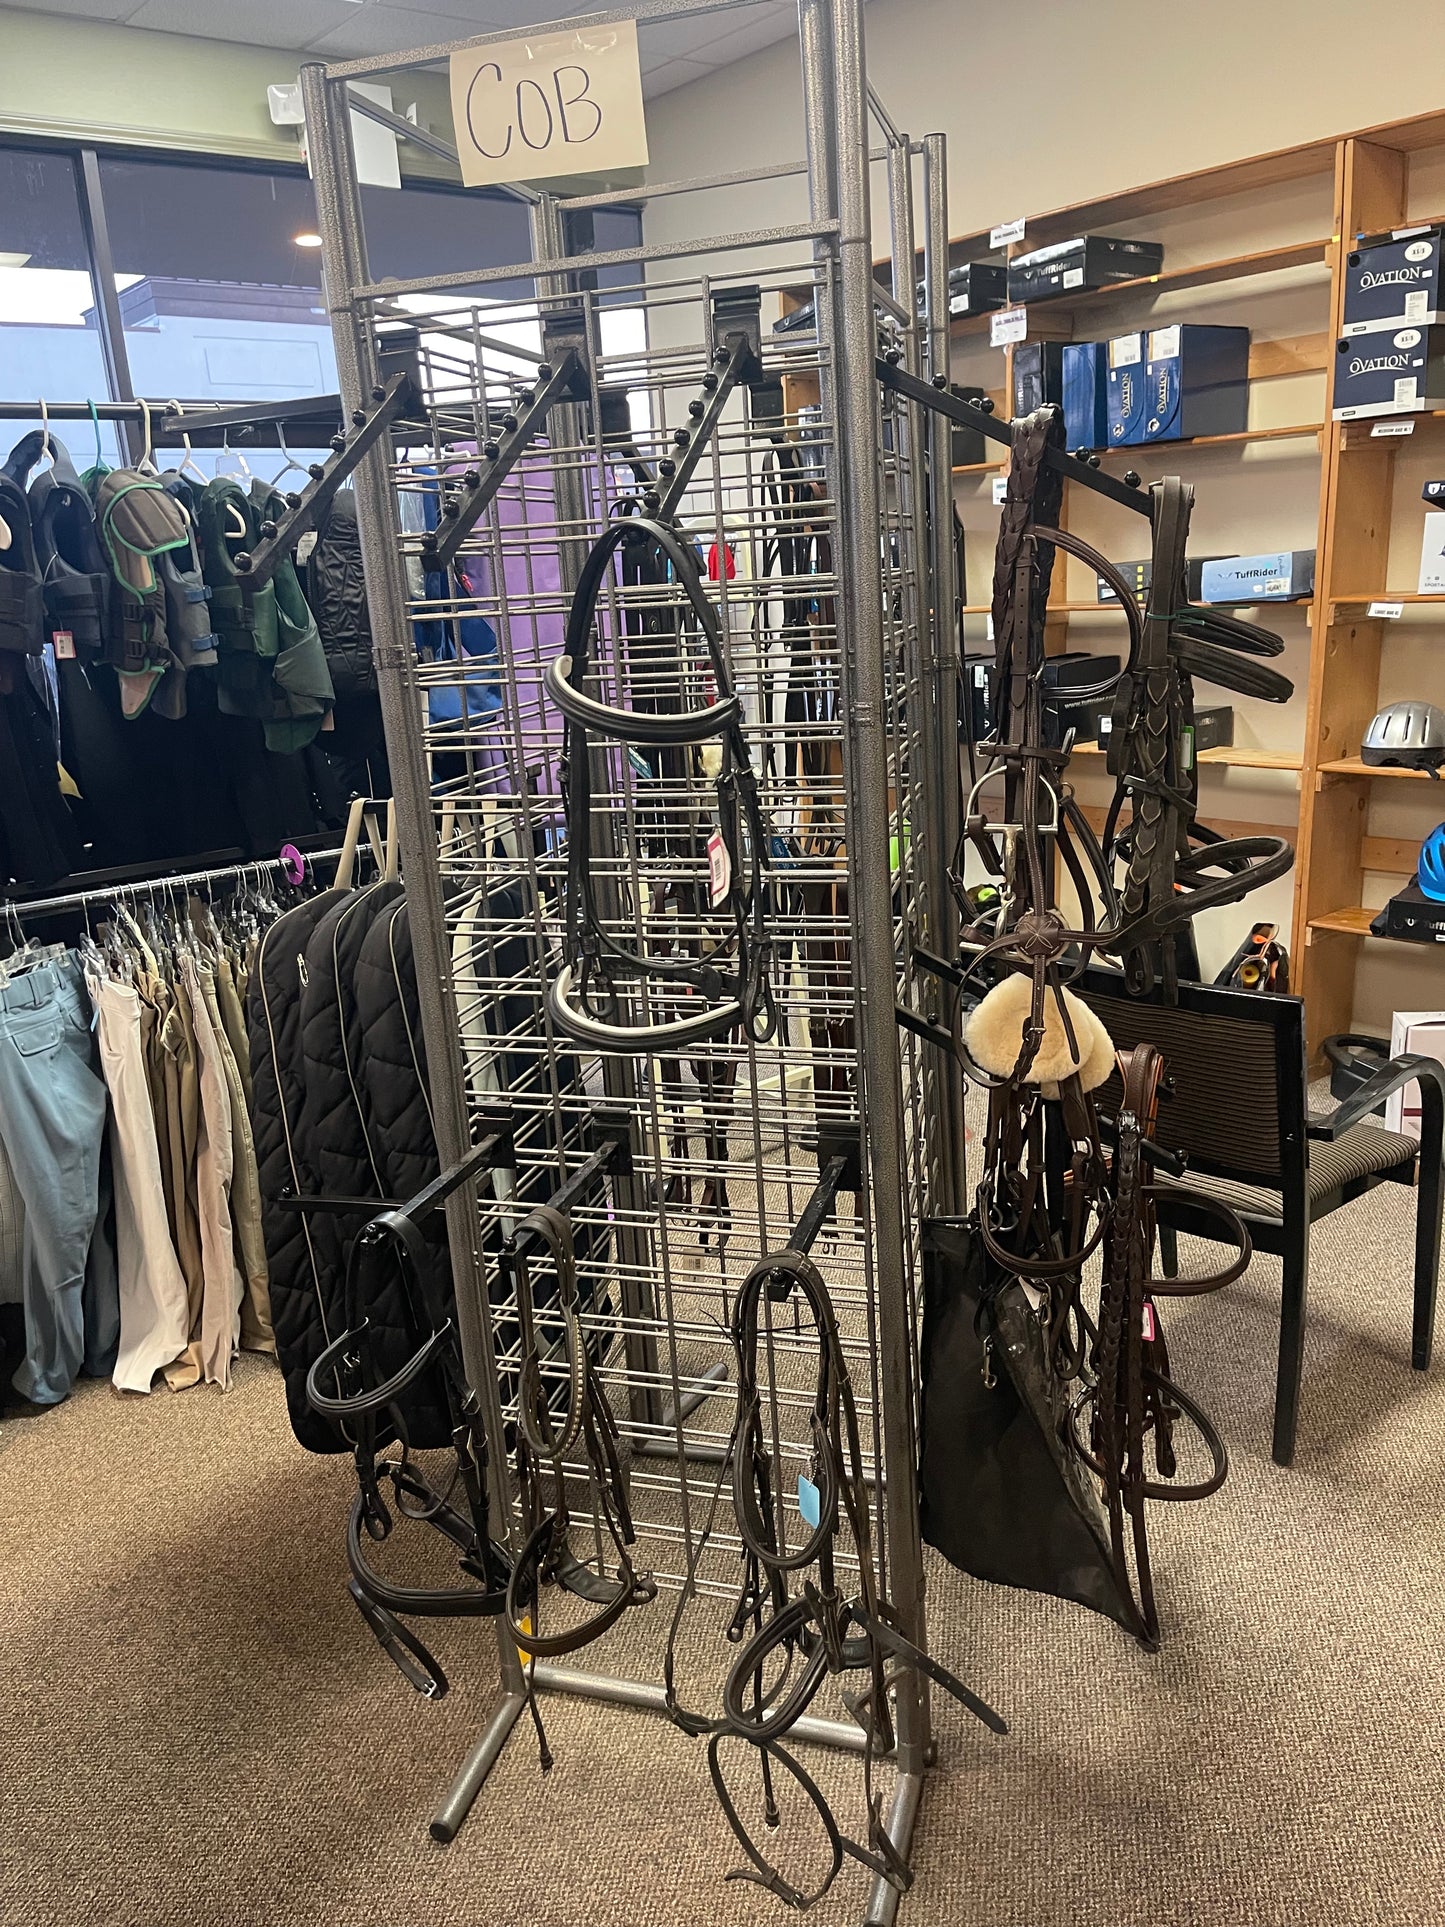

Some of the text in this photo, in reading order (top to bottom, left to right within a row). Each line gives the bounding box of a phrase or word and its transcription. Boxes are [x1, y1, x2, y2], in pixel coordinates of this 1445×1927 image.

[466, 62, 602, 159] COB
[1360, 266, 1422, 290] OVATION
[1349, 353, 1409, 375] OVATION
[1121, 372, 1131, 418] OVATION
[1157, 367, 1168, 414] OVATION
[1235, 568, 1278, 579] TuffRider
